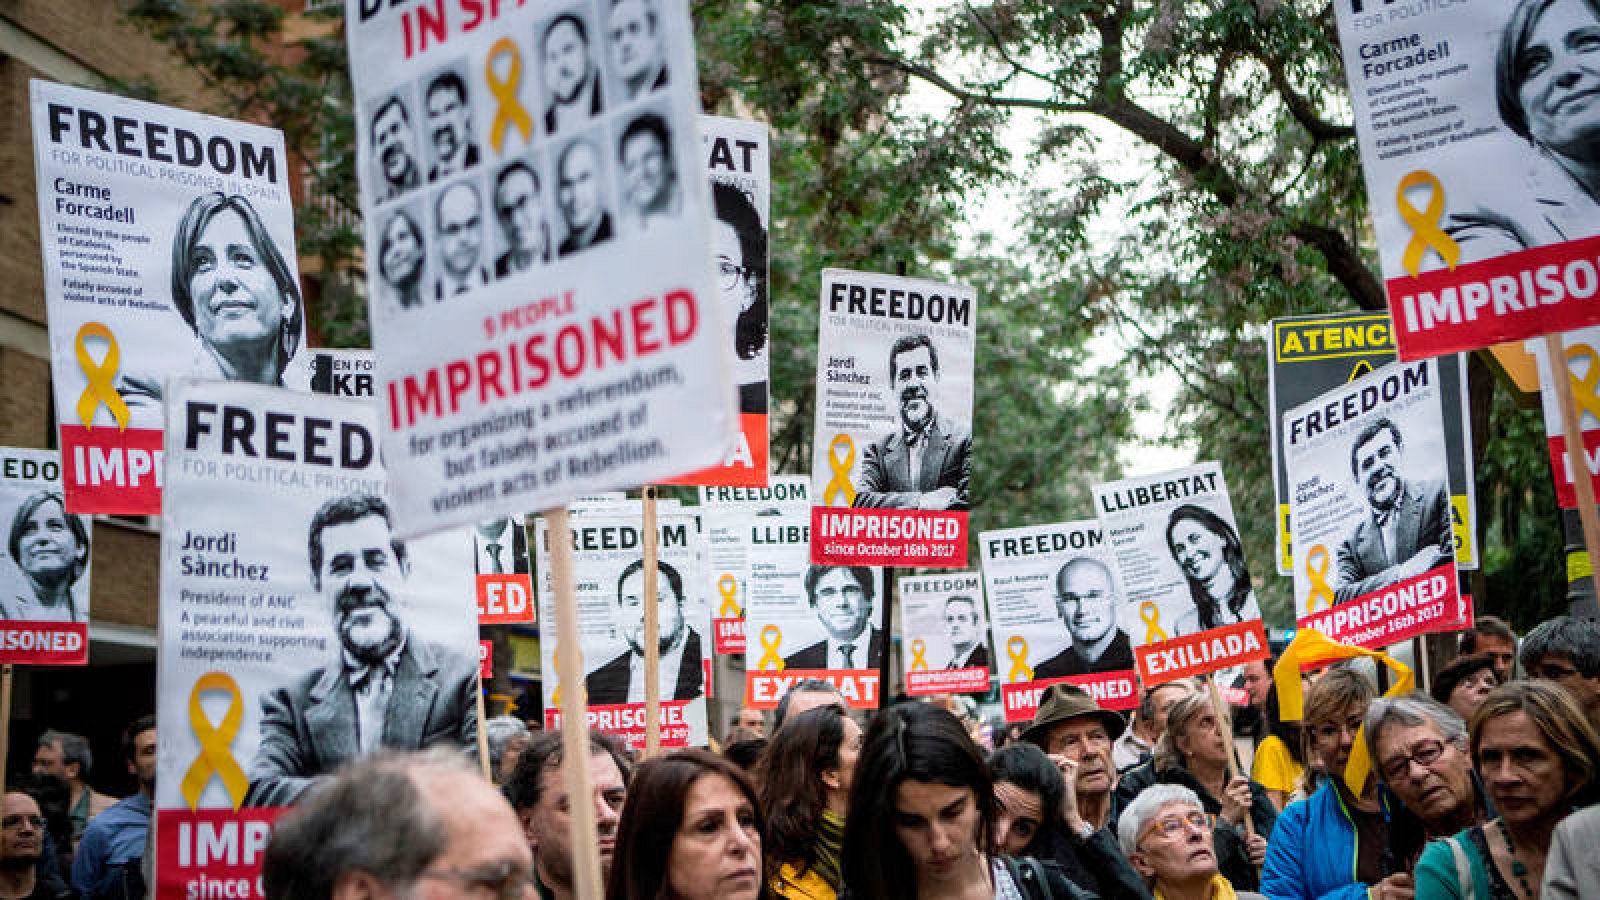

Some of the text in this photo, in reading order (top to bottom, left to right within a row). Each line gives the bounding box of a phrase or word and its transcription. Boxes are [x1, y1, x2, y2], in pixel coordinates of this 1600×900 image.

[401, 0, 448, 60] IN
[1360, 34, 1420, 60] Carme
[1363, 40, 1449, 78] Forcadell
[48, 101, 278, 184] FREEDOM
[52, 150, 81, 165] FOR
[85, 155, 154, 177] POLITICAL
[55, 178, 111, 201] Carme
[55, 197, 135, 224] Forcadell
[830, 284, 970, 326] FREEDOM
[1403, 256, 1600, 332] IMPRISO
[501, 290, 575, 332] PEOPLE
[387, 288, 700, 431] IMPRISONED
[827, 355, 854, 369] Jordi
[408, 364, 685, 456] for organizing a referendum,
[1290, 361, 1430, 445] FREEDOM
[185, 401, 387, 471] FREED
[444, 404, 647, 480] but falsely accused of
[182, 457, 217, 480] FOR
[225, 463, 312, 490] POLITICAL
[432, 436, 670, 513] violent acts of Rebellion.
[705, 484, 807, 502] FREEDOM
[1101, 472, 1217, 513] LLIBERTAT
[181, 531, 237, 554] Jordi
[821, 514, 960, 541] IMPRISONED
[824, 540, 955, 557] since October 16th 2017
[180, 552, 269, 581] Sànchez
[180, 588, 296, 608] President of ANC
[903, 577, 978, 593] FREEDOM
[181, 610, 305, 629] A peaceful and civil
[1388, 613, 1415, 633] 16th
[1417, 602, 1445, 623] 2017
[181, 629, 327, 651] association supporting
[1145, 631, 1260, 675] EXILIADA
[186, 872, 250, 899] since
